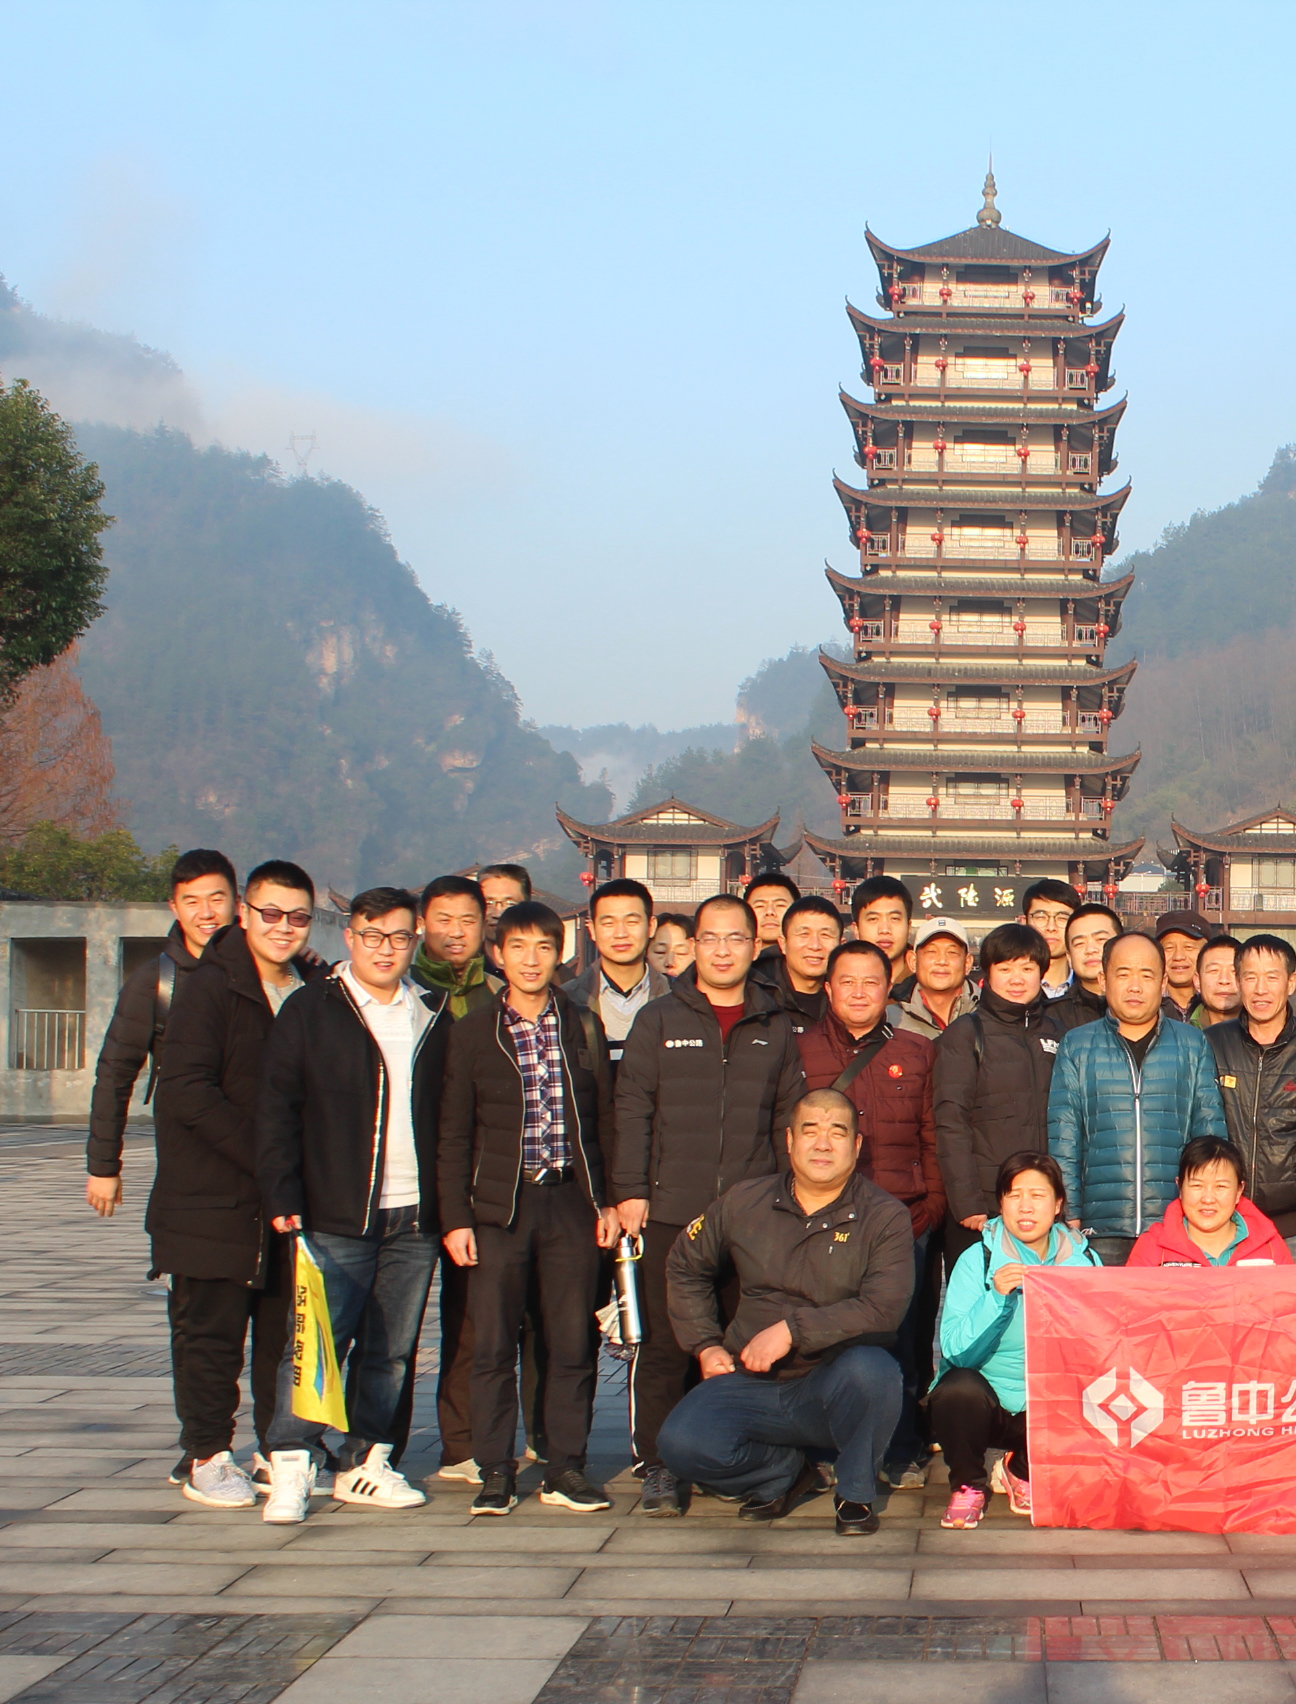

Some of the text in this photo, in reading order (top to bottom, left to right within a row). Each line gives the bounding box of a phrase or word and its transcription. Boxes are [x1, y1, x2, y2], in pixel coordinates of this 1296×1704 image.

[919, 882, 1016, 908] 武陵源
[1182, 1426, 1275, 1439] LUZHONG
